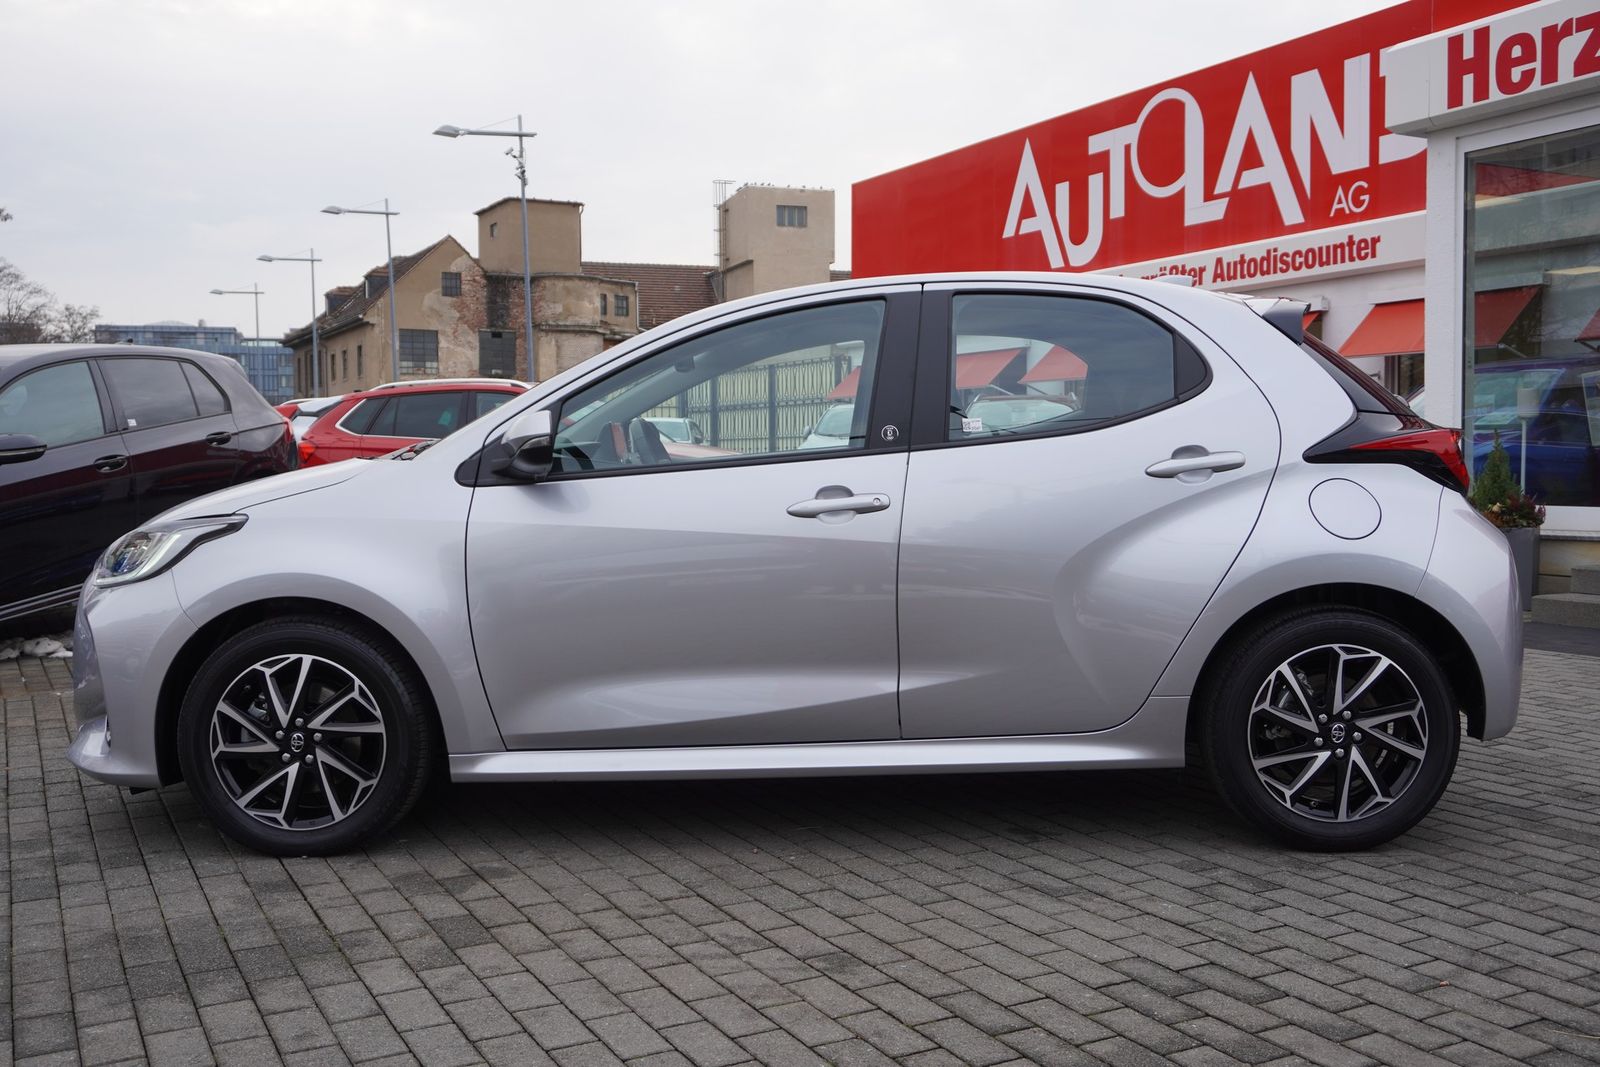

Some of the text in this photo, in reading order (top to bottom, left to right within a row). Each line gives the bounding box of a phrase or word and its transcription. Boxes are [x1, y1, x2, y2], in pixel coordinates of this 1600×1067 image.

[1447, 11, 1600, 109] Herz
[1329, 180, 1370, 217] AG
[1212, 235, 1381, 284] Autodiscounter
